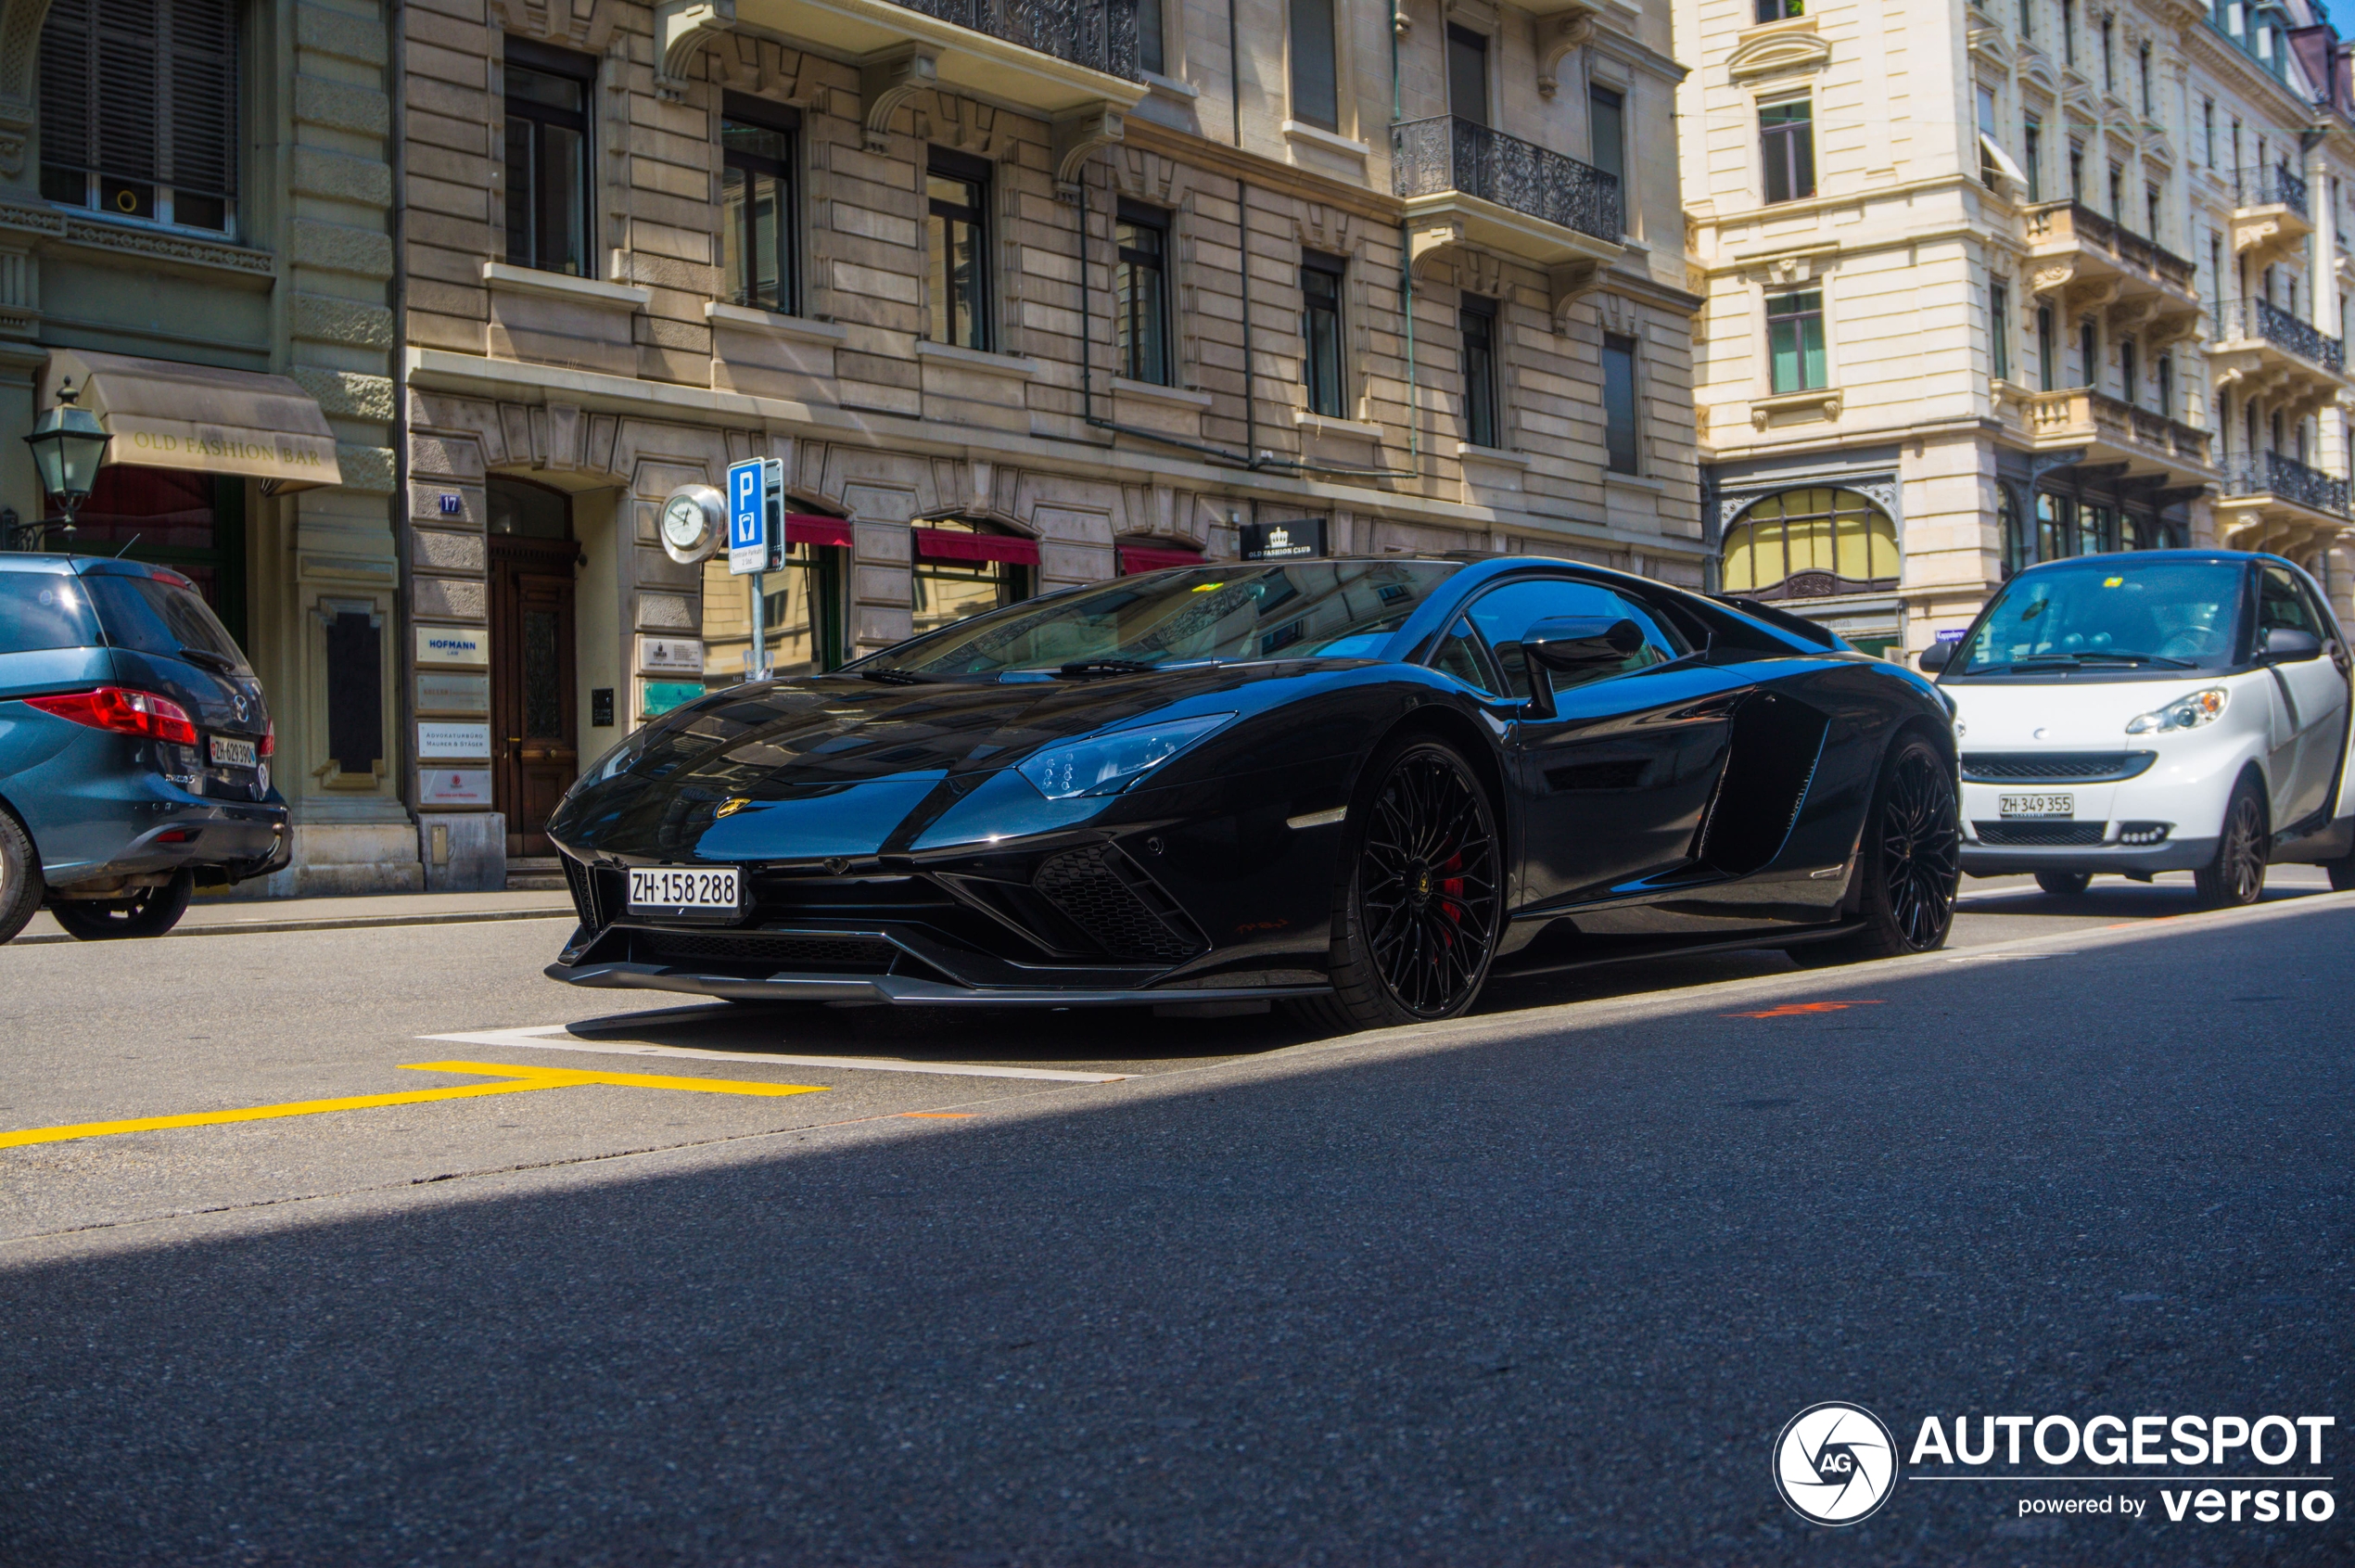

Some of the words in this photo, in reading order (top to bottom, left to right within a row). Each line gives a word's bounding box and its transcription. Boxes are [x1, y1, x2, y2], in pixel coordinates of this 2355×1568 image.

[134, 431, 177, 451] OLD
[185, 437, 274, 462] FASHION
[283, 447, 321, 465] BAR
[739, 471, 754, 511] P
[444, 496, 457, 511] 17
[1248, 550, 1262, 558] OLD
[1263, 547, 1292, 556] FASHION
[1292, 545, 1311, 555] CLUB
[429, 639, 476, 650] HOFMANN
[2047, 797, 2071, 811] 355
[699, 874, 735, 903] 288
